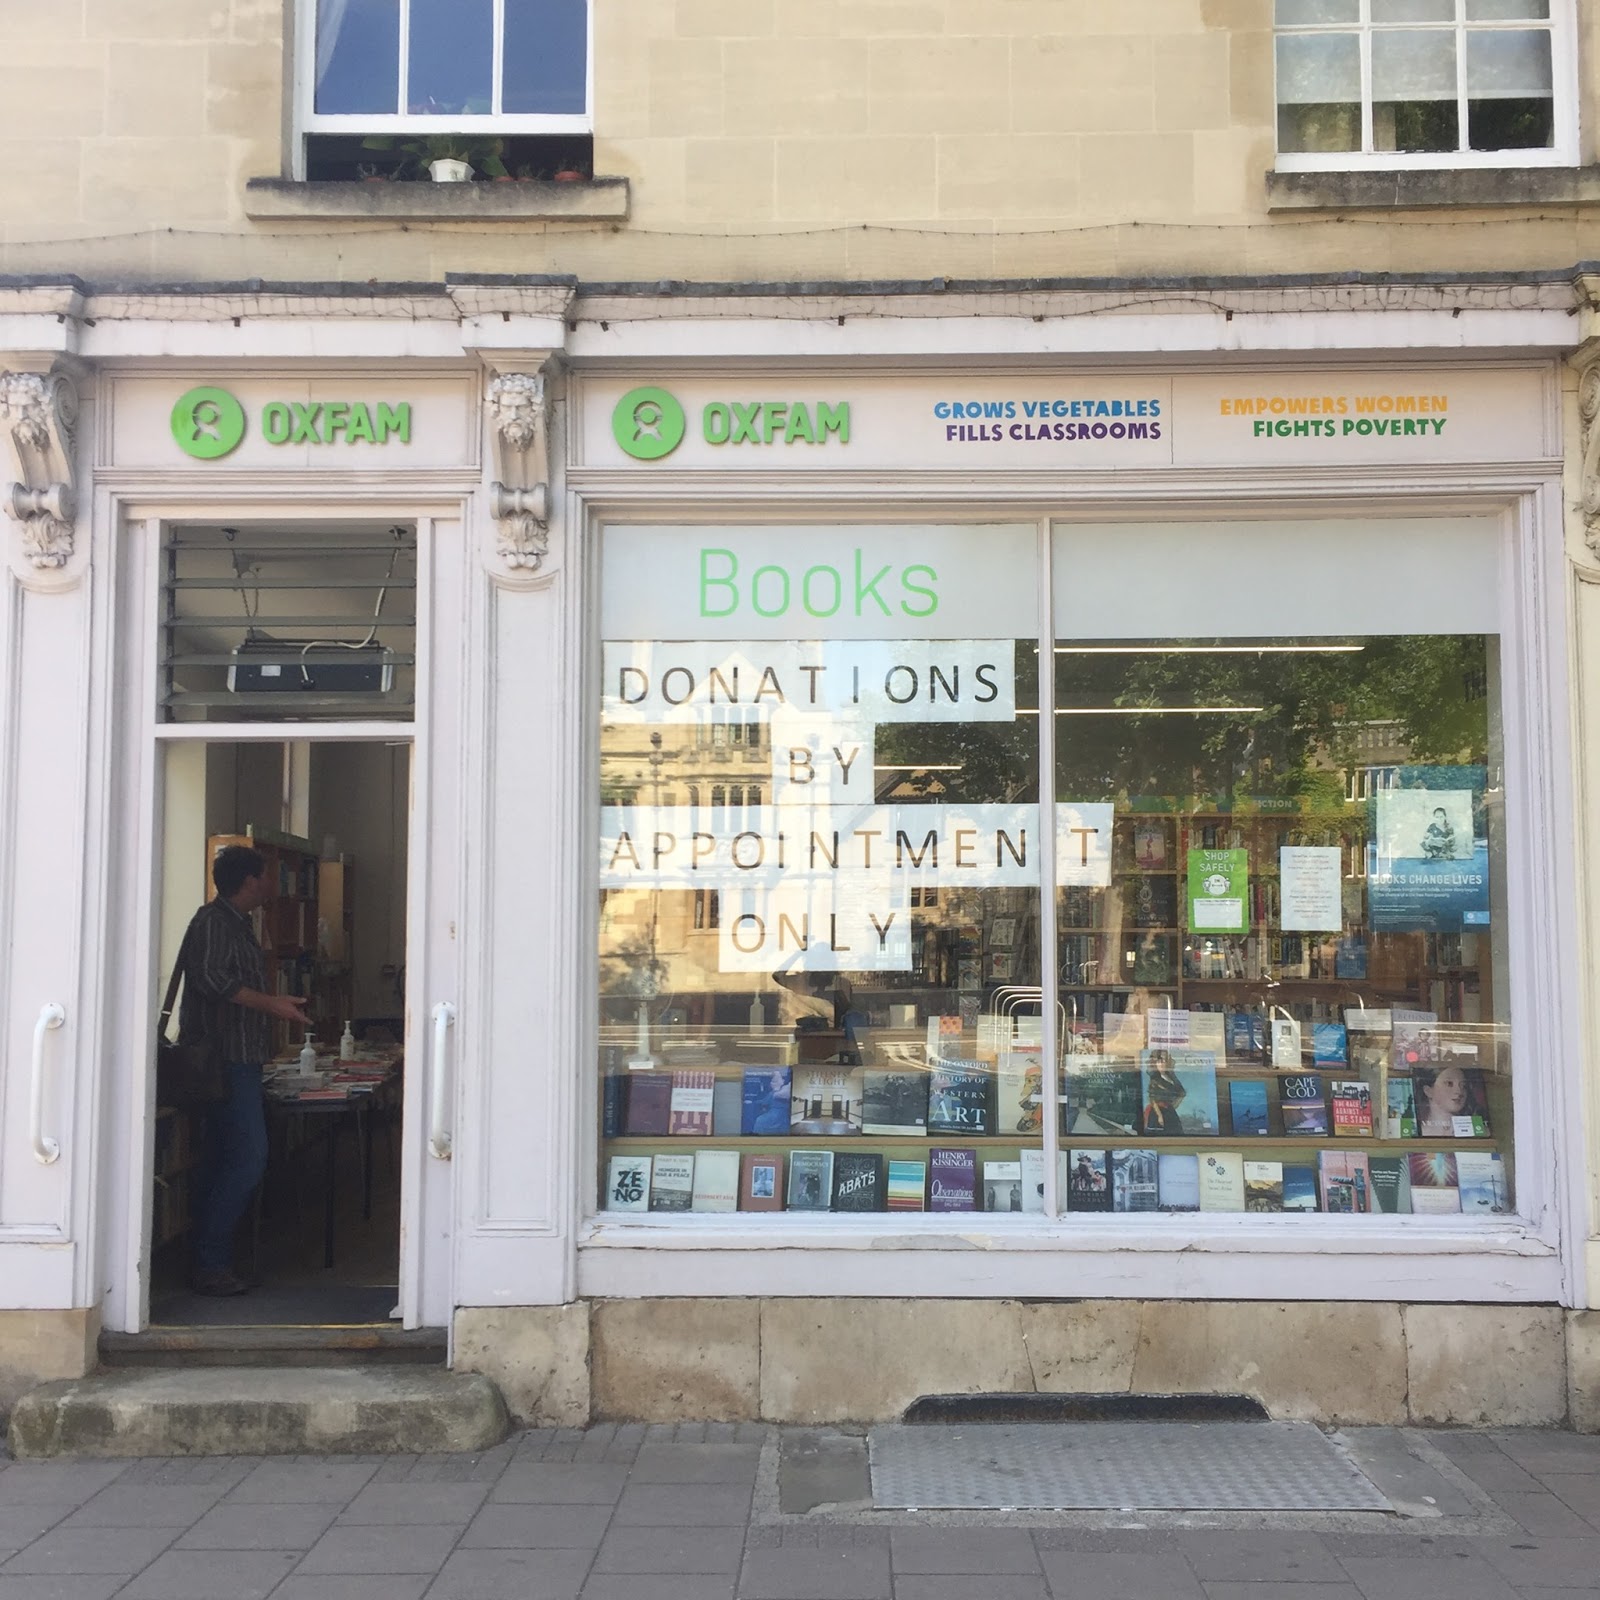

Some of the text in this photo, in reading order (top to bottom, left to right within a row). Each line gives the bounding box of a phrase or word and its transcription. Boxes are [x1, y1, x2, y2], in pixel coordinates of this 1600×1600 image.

[934, 399, 1161, 420] GROWS VEGETABLES
[1220, 395, 1448, 415] EMPOWERS WOMEN
[261, 400, 412, 445] OXFAM
[702, 400, 851, 445] OXFAM
[946, 421, 1161, 442] FILLS CLASSROOMS
[1253, 418, 1447, 438] FIGHTS POVERTY
[700, 547, 940, 618] Books
[618, 663, 999, 705] DONATIONS
[788, 746, 860, 786] BY
[608, 828, 1099, 871] APPOINTMENT
[1205, 851, 1230, 861] SHOP
[1199, 863, 1235, 872] SAFELY
[1373, 874, 1483, 885] BOOKS CHANGE LIVES
[731, 911, 897, 953] ONLY
[934, 1074, 987, 1084] HISTORY OF
[1284, 1077, 1315, 1088] CAPE
[933, 1090, 986, 1099] WESTERN
[1286, 1087, 1317, 1098] COD
[931, 1100, 987, 1123] ART
[1336, 1115, 1371, 1123] THE STASI
[932, 1158, 974, 1167] KISSINGER
[938, 1152, 967, 1160] HENRY
[617, 1170, 643, 1188] ZE
[838, 1170, 876, 1197] ABATS
[931, 1179, 974, 1198] Observations
[612, 1189, 644, 1202] NO
